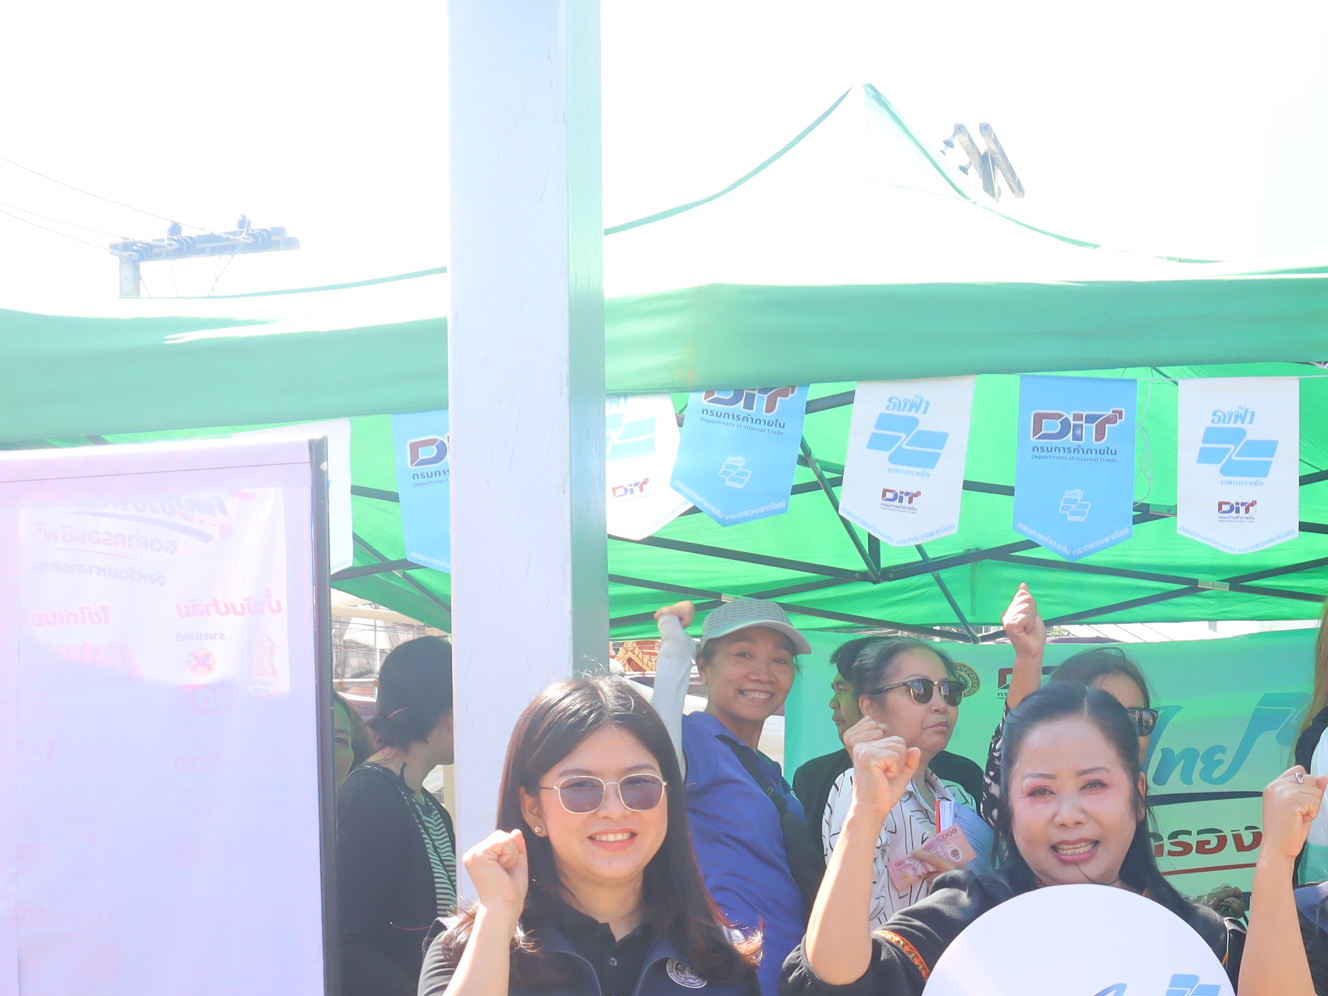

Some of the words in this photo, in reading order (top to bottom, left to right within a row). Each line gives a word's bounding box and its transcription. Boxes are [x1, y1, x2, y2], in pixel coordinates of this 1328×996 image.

[885, 394, 931, 415] ธงฟ้า
[701, 408, 786, 429] กรมการค้าภายใน
[1211, 405, 1256, 425] ธงฟ้า
[1032, 445, 1117, 456] กรมการค้าภายใน
